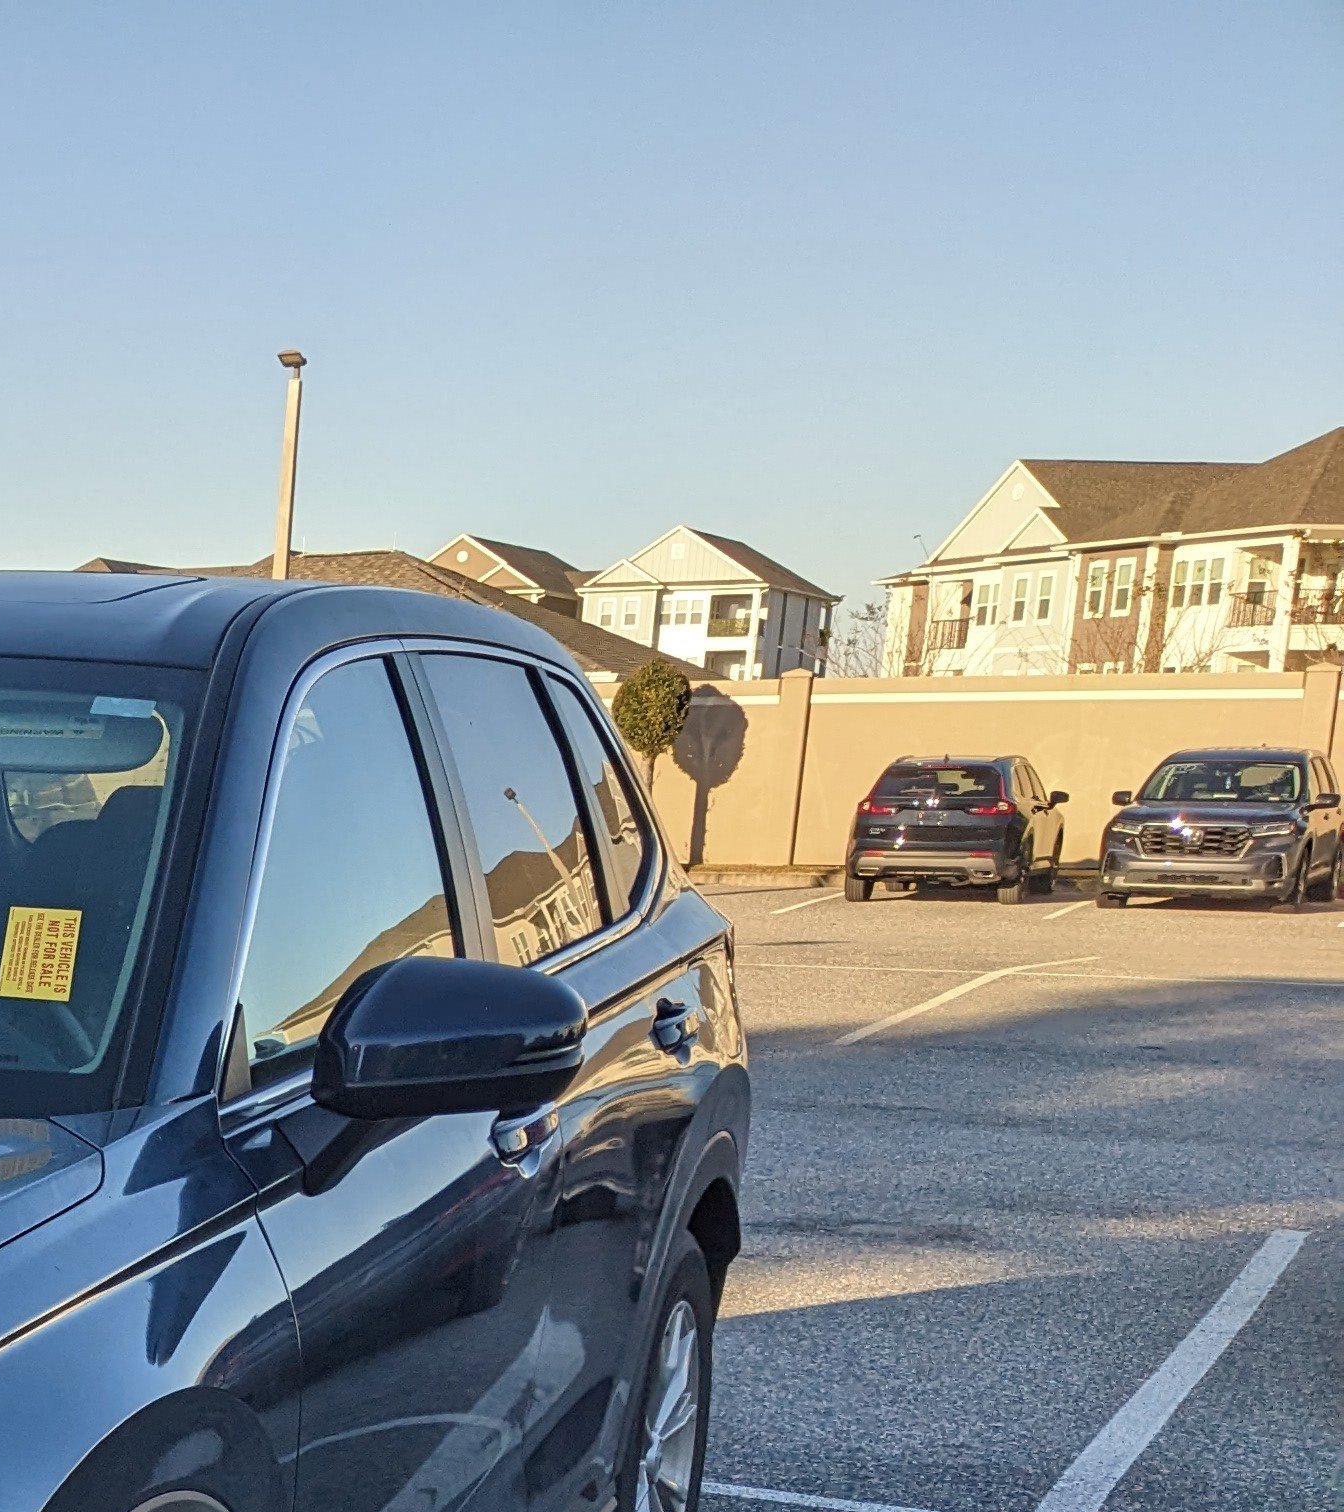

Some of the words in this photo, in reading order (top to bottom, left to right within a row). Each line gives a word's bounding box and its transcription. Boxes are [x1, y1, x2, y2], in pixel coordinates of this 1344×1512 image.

[46, 920, 61, 938] NOT
[62, 916, 78, 939] THIS
[43, 941, 58, 960] FOR
[55, 941, 73, 981] VEHICLE
[38, 963, 54, 987] SALE
[53, 983, 67, 994] IS
